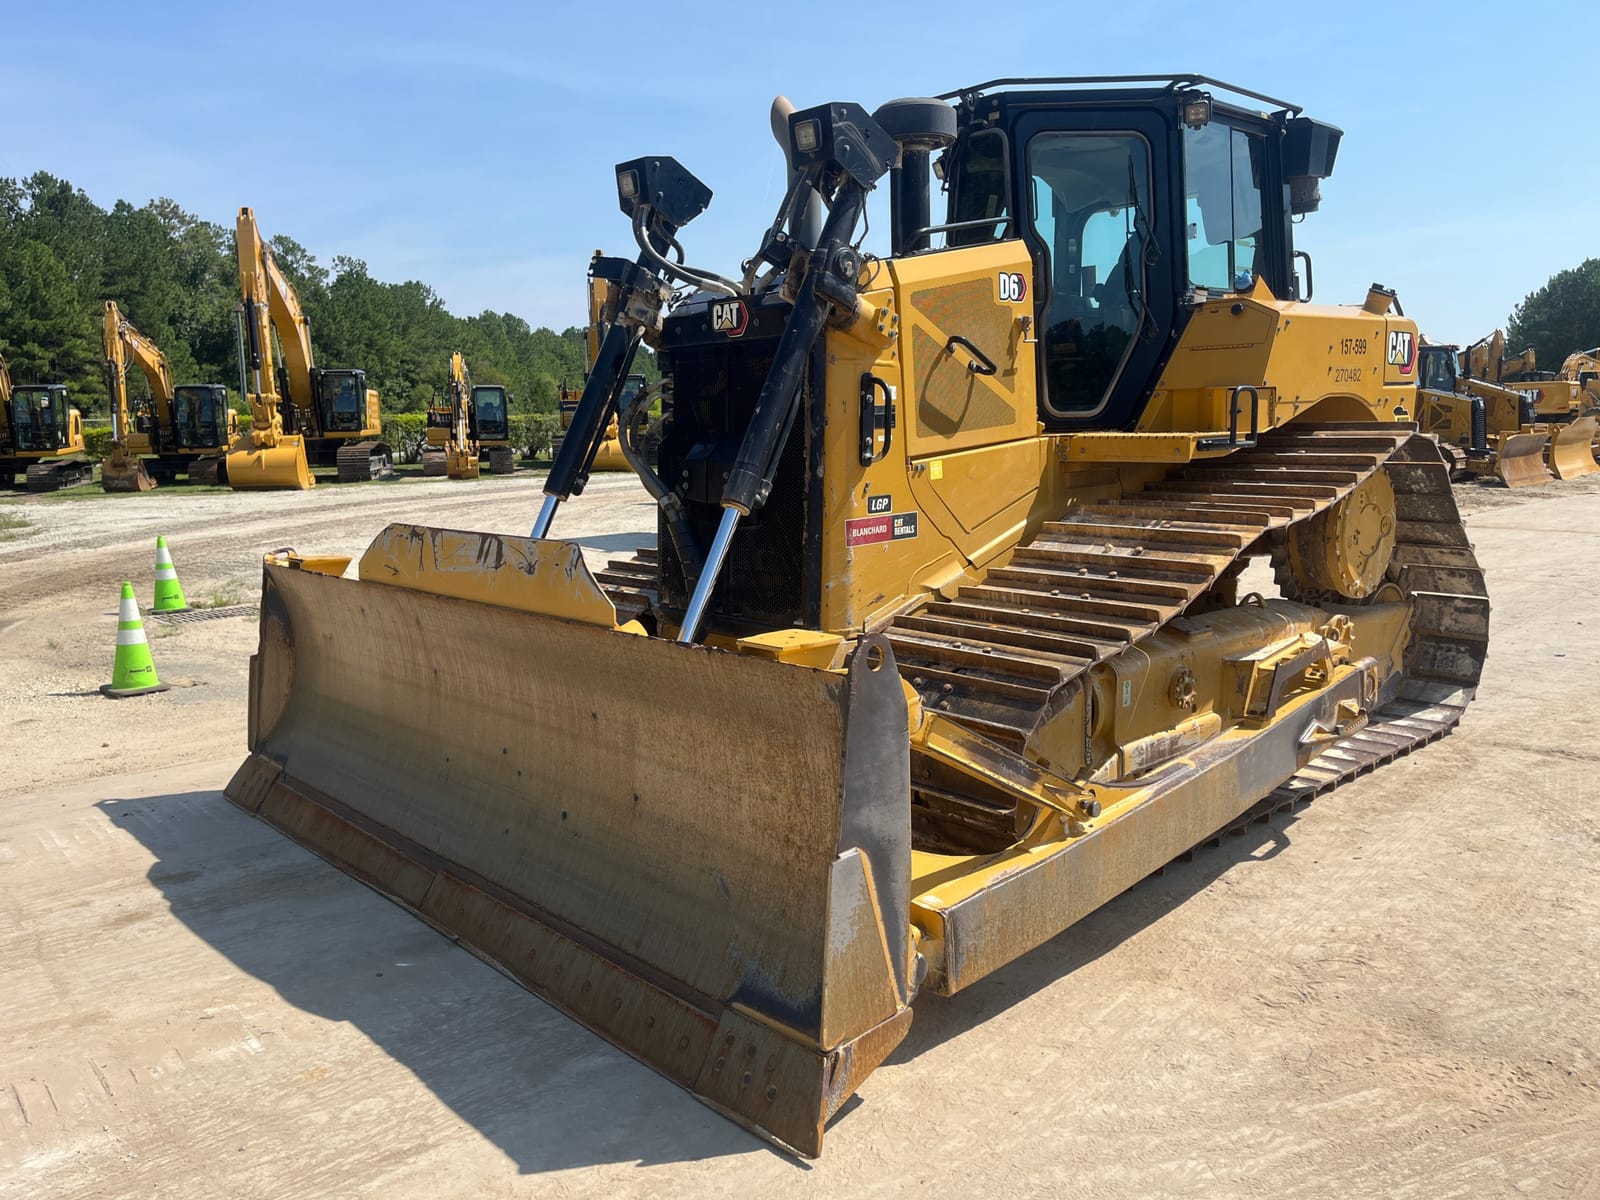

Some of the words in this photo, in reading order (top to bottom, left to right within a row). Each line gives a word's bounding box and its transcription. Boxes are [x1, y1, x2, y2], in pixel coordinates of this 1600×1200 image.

[999, 273, 1018, 300] D6
[713, 303, 739, 330] CAT
[1341, 339, 1367, 355] 157-599
[1388, 331, 1411, 365] CAT
[1335, 368, 1361, 382] 270482
[871, 498, 889, 511] LGP
[852, 525, 887, 537] BLANCHARD
[894, 525, 915, 536] RENTALS
